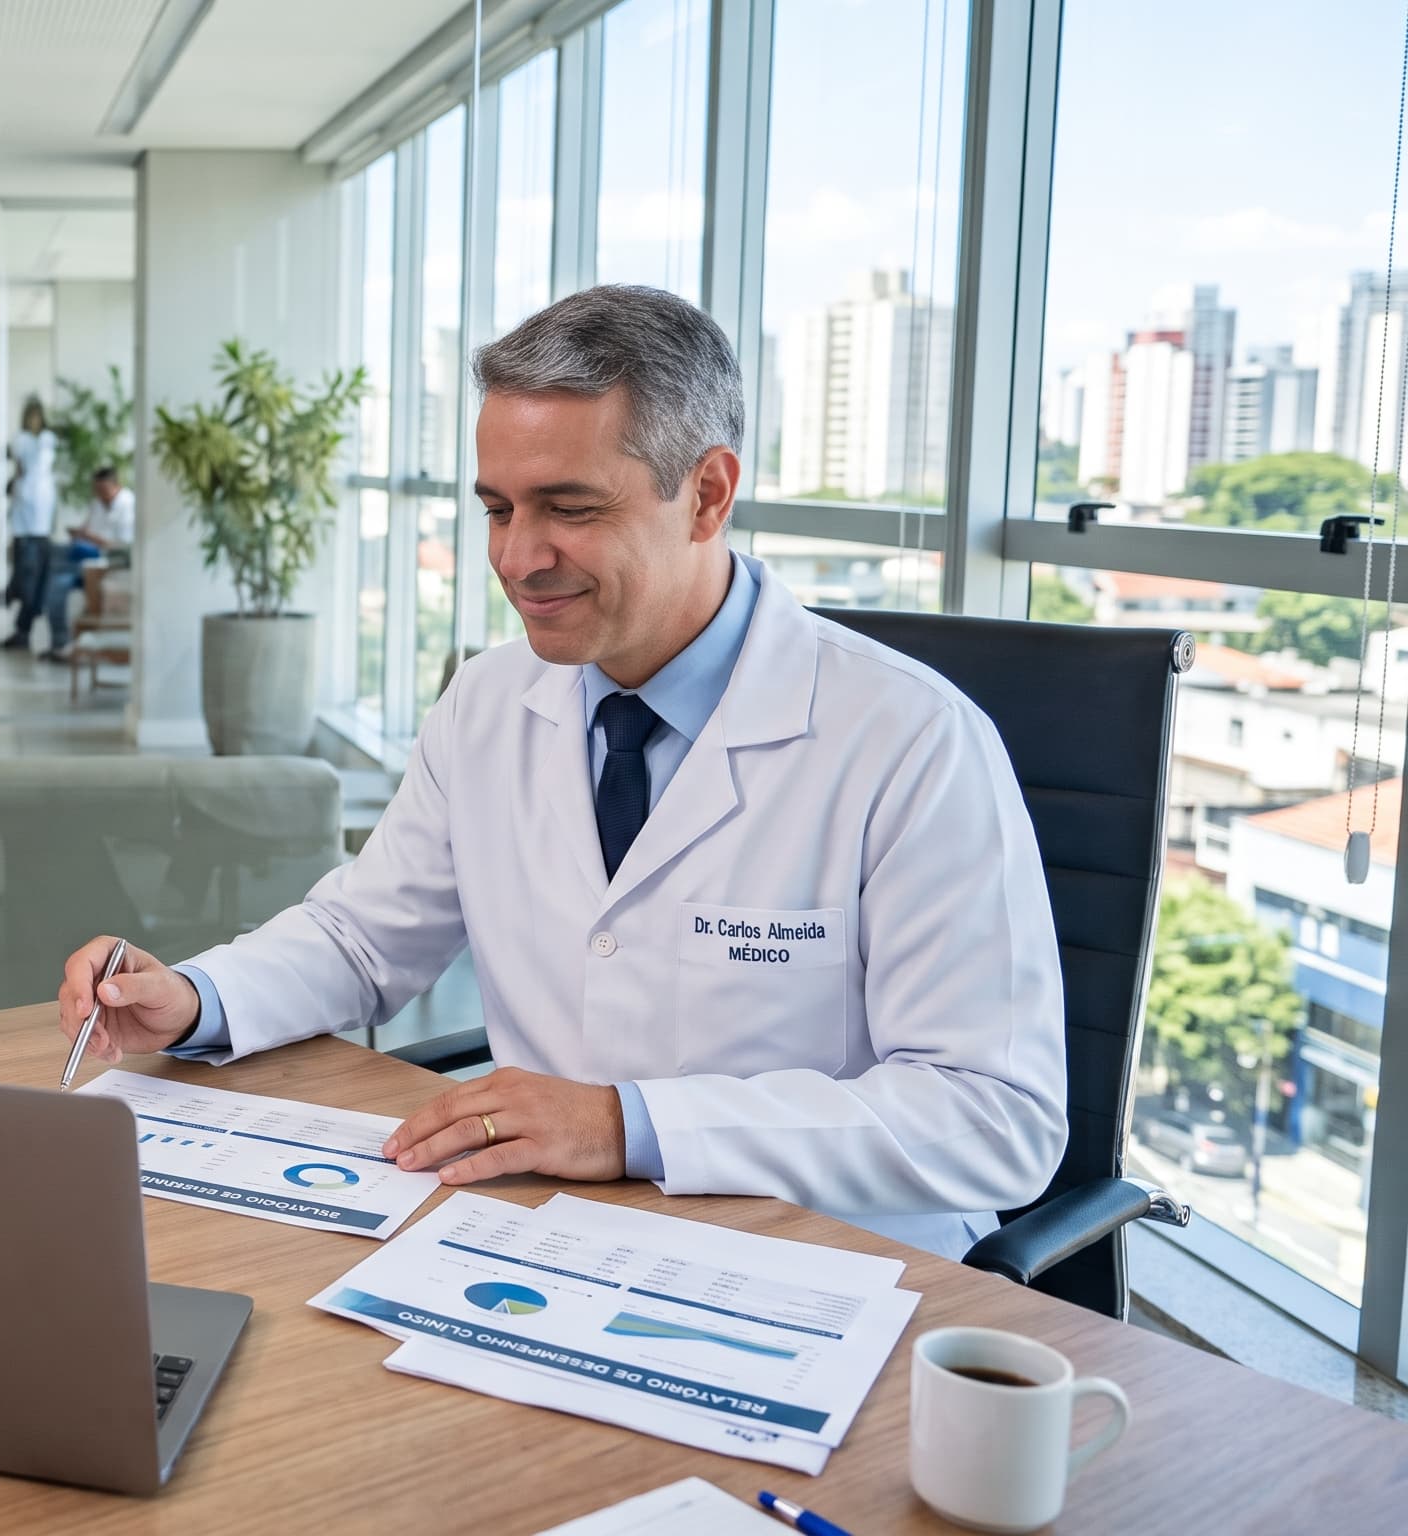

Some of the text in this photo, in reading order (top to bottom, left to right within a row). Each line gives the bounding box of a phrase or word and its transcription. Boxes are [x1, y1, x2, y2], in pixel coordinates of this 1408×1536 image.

[694, 916, 826, 941] Dr. Carlos Almeida
[728, 942, 790, 963] MÉDICO
[613, 1368, 643, 1383] DE
[646, 1377, 768, 1415] RELATÓRIO
